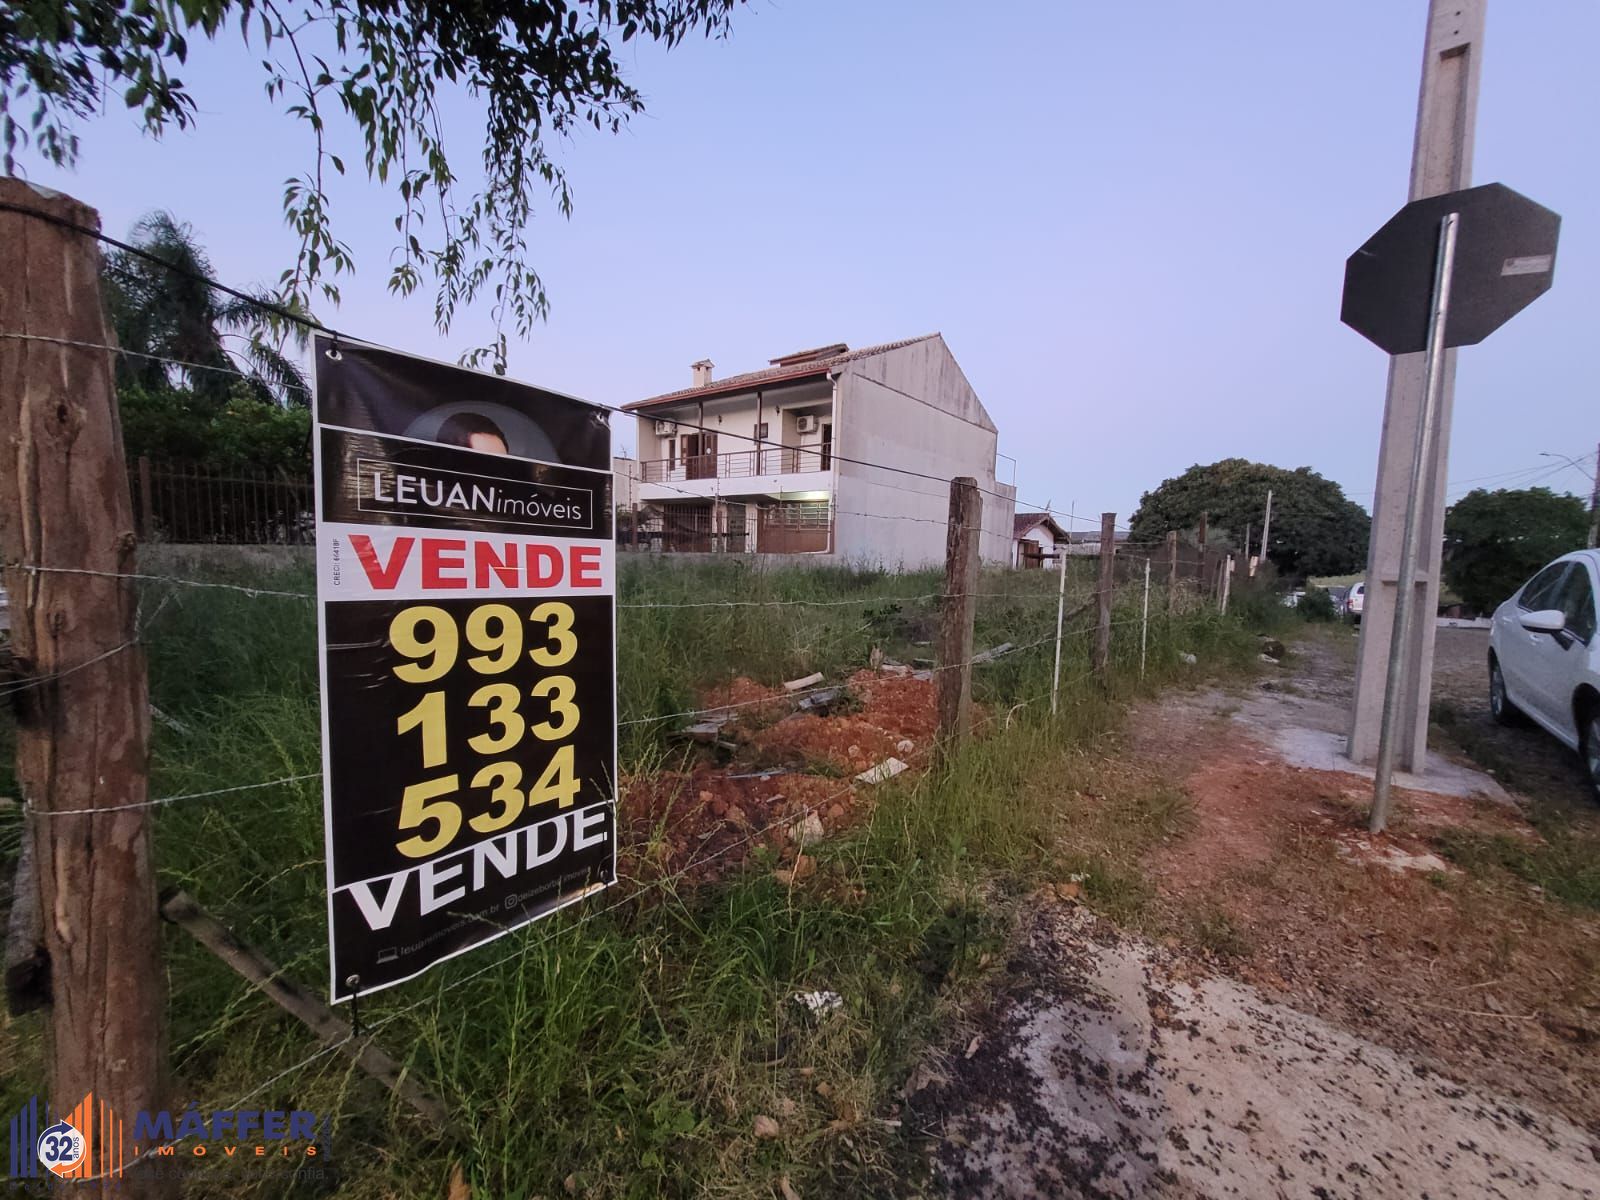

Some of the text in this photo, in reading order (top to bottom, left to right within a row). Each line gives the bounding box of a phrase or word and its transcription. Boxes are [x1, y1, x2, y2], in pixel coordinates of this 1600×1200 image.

[373, 471, 582, 520] LEUANimóveis
[347, 534, 603, 590] VENDE
[389, 602, 578, 683] 993
[397, 675, 581, 768] 133
[395, 745, 581, 858] 534
[349, 812, 607, 931] VENDE
